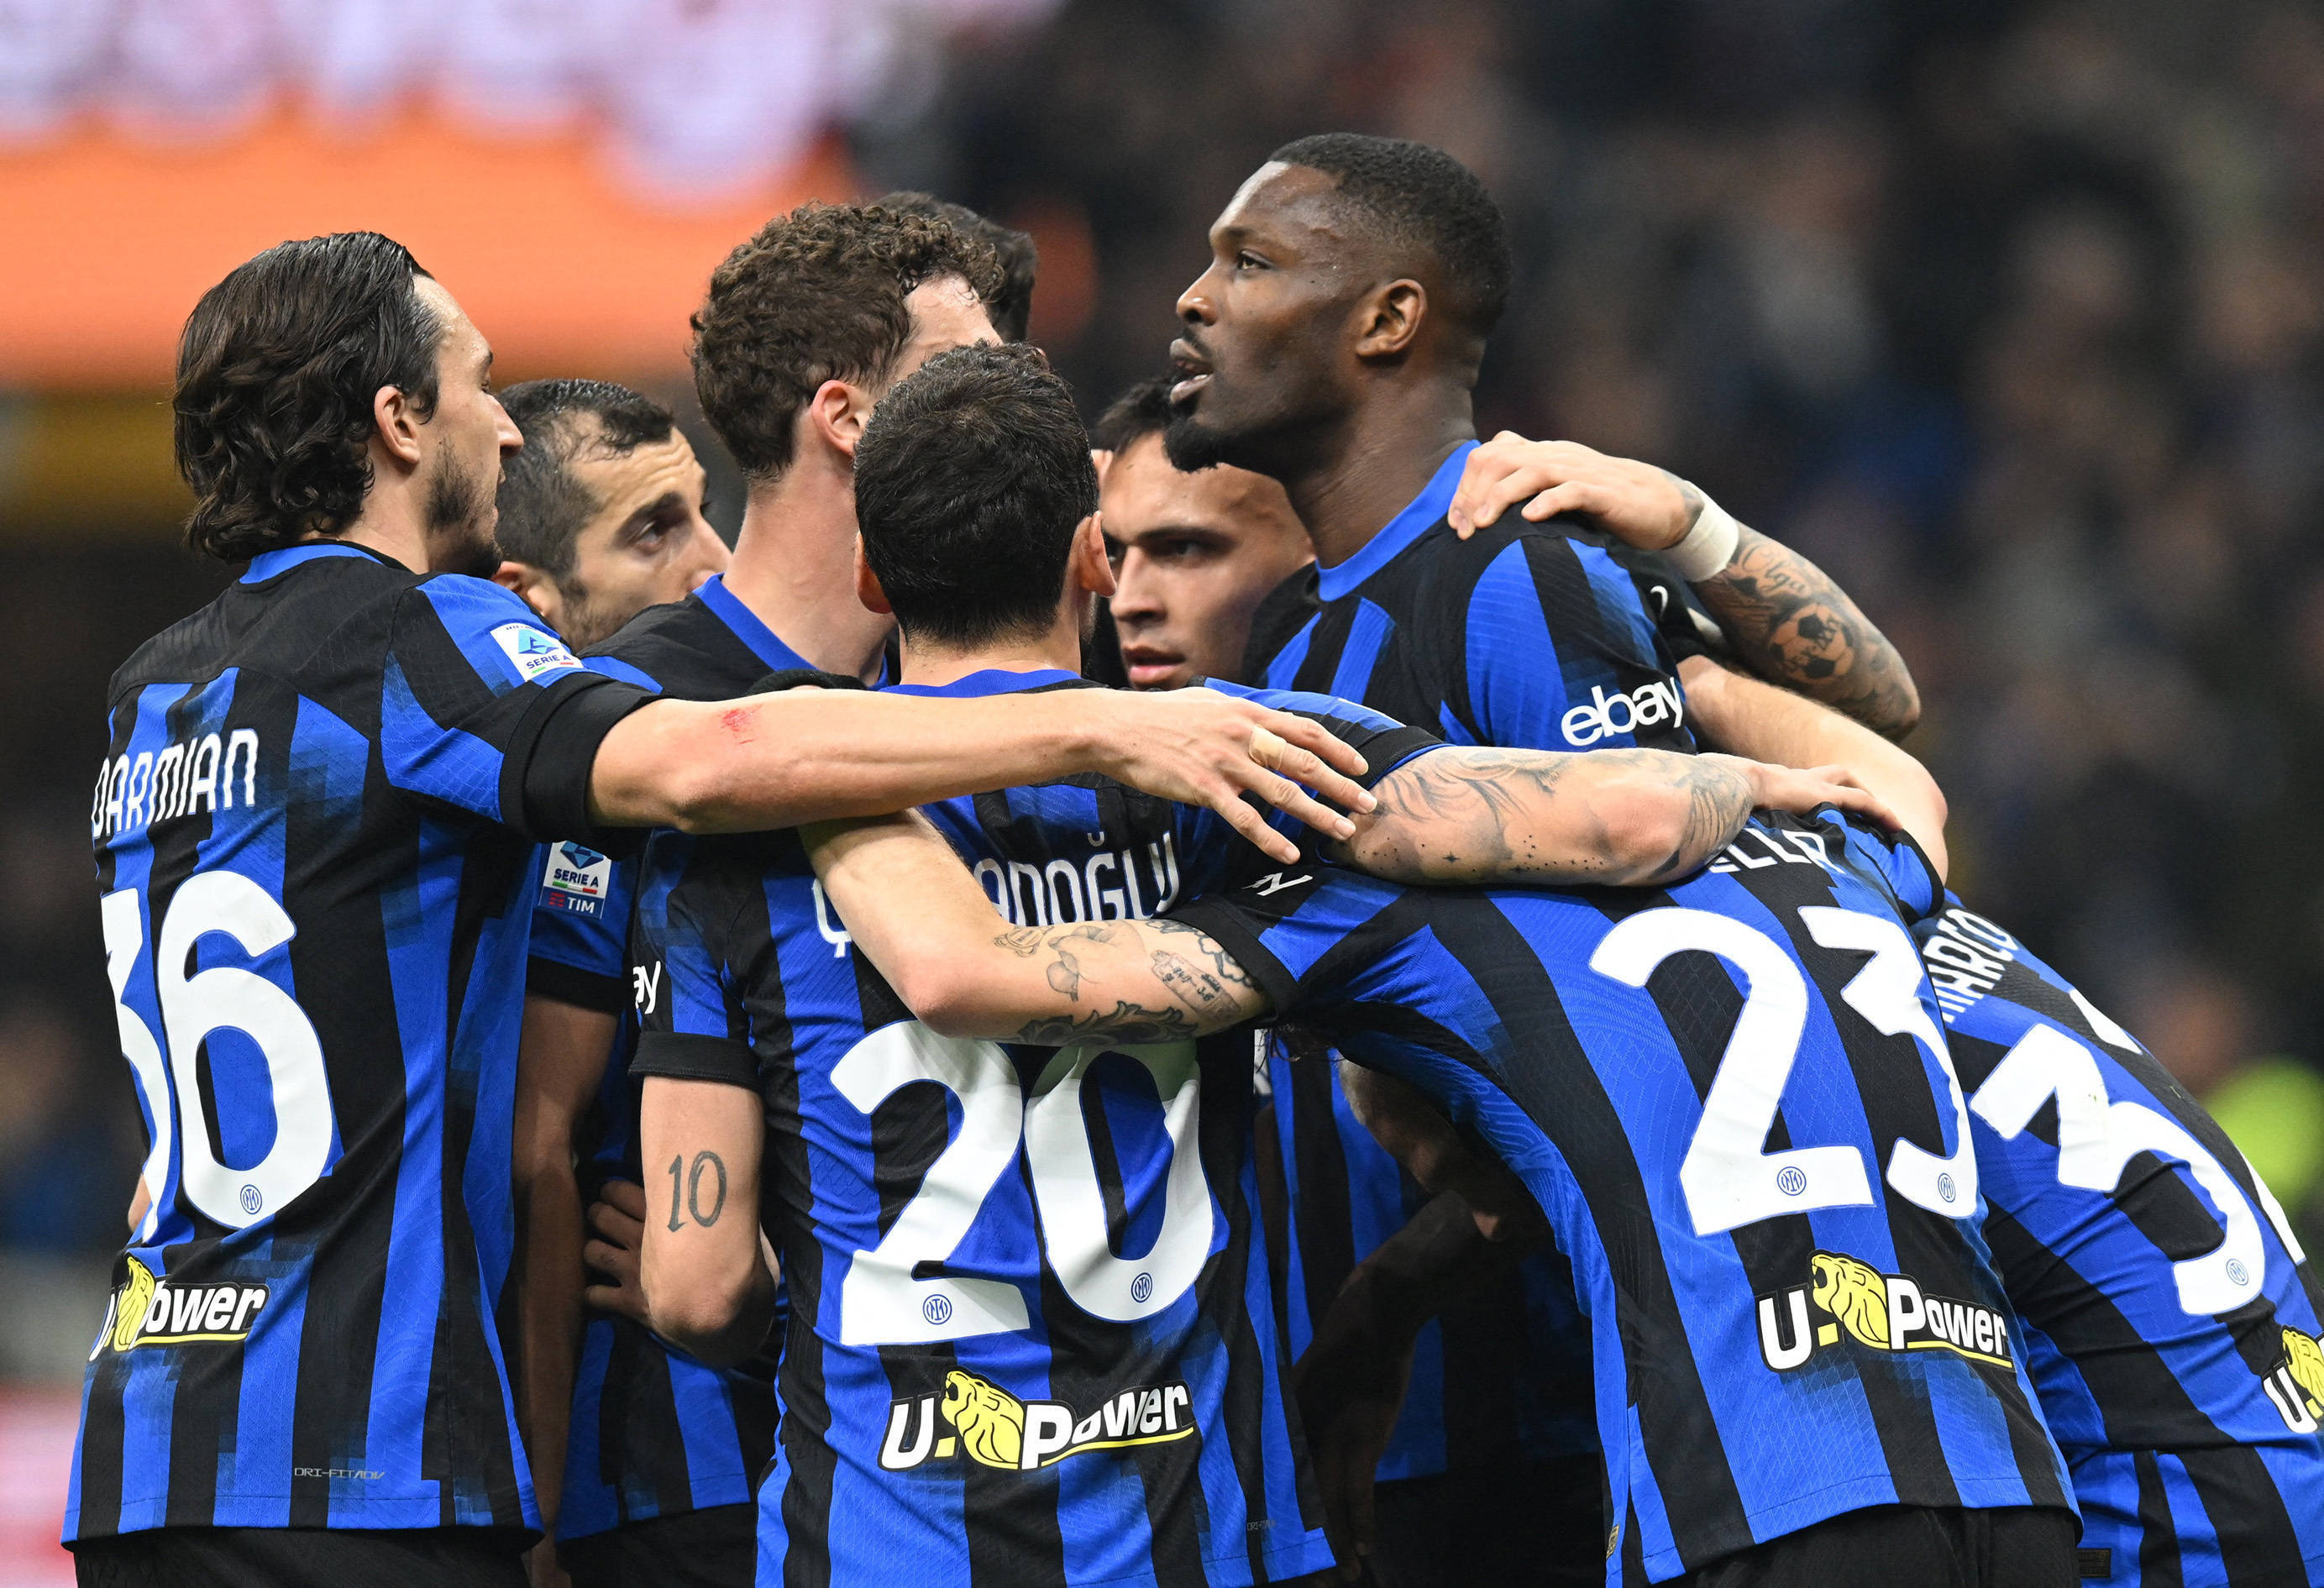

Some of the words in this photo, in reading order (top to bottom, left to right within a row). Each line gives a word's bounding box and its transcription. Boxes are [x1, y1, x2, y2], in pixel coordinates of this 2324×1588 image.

[526, 655, 560, 669] SERIE
[1561, 677, 1682, 746] ebay
[92, 729, 259, 839] DARMIAN
[553, 868, 590, 885] SERIE
[590, 876, 599, 888] A
[568, 897, 595, 914] TIM
[1590, 907, 1979, 1236] 23
[668, 1150, 727, 1233] 10
[829, 1019, 1214, 1345] 20
